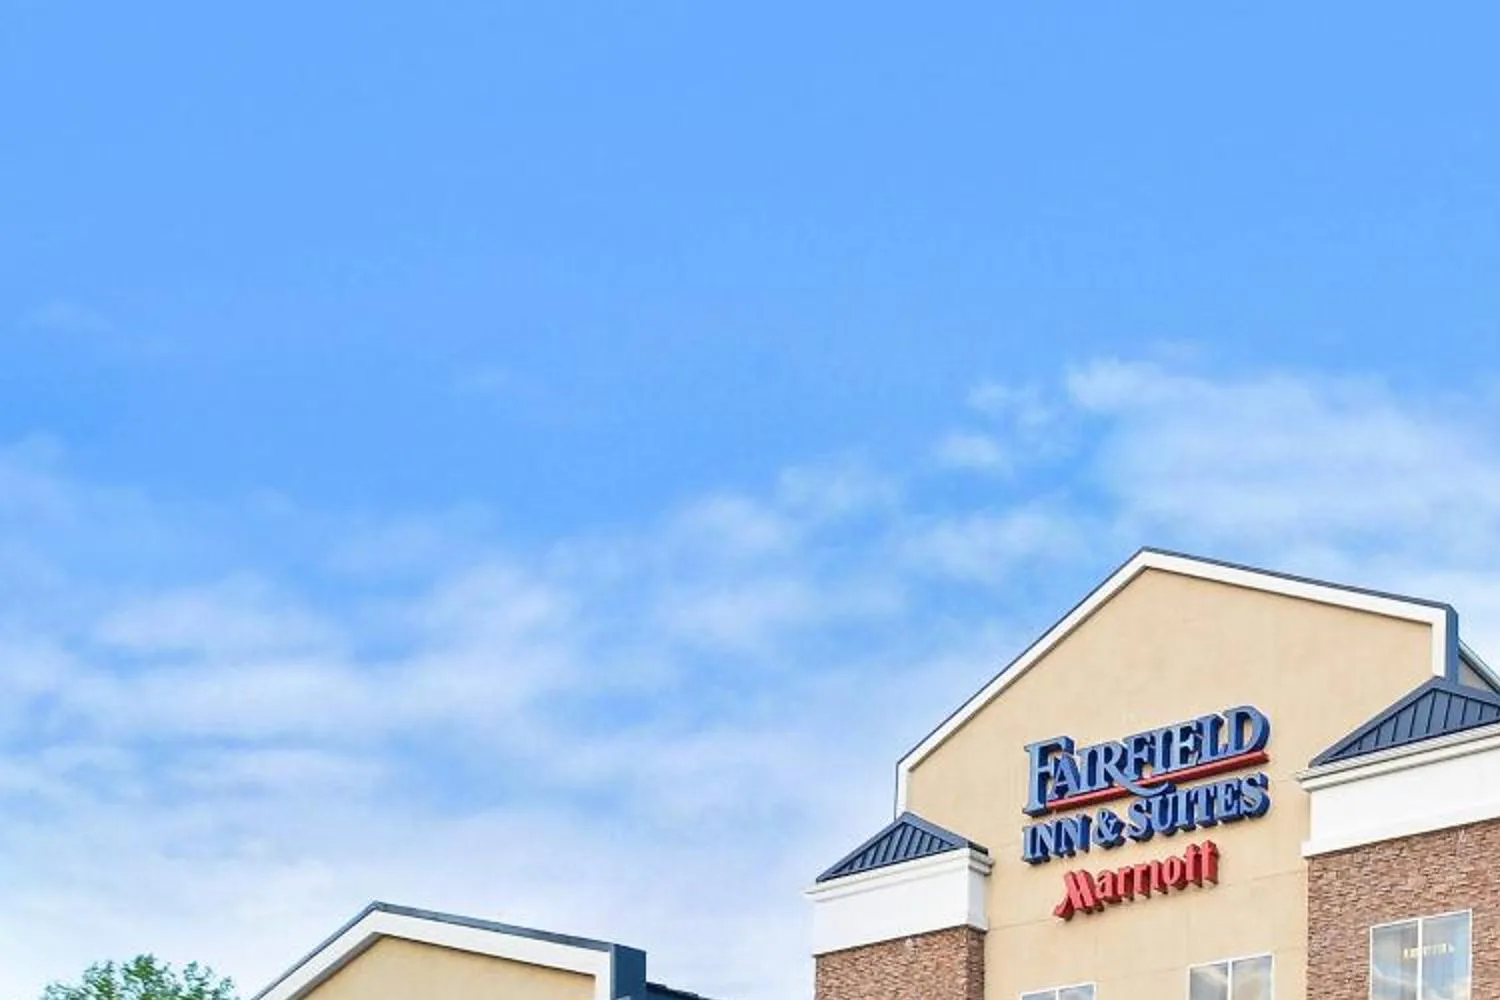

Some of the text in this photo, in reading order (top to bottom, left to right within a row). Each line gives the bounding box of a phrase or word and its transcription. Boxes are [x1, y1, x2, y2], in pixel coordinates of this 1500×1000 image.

[1022, 704, 1271, 817] FAIRFIELD
[1022, 771, 1271, 865] INN & SUITES
[1053, 839, 1220, 921] Marriott
